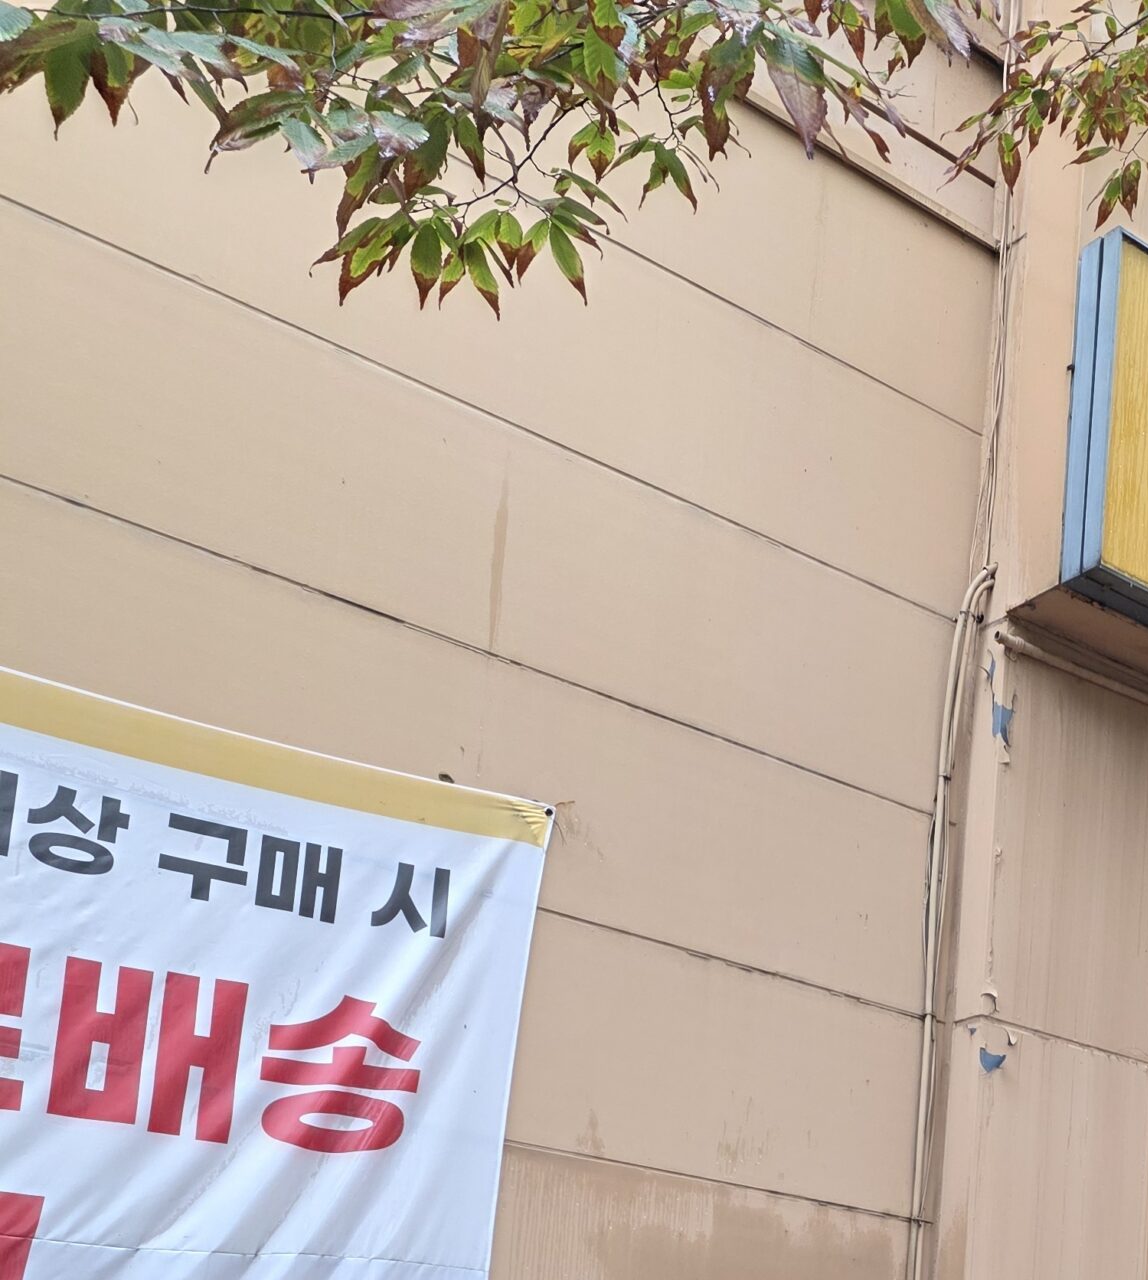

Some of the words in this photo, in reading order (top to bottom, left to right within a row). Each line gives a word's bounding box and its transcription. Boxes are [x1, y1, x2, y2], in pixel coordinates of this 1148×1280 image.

[158, 813, 343, 924] 구매
[370, 861, 451, 939] 시
[0, 942, 422, 1153] 배송
